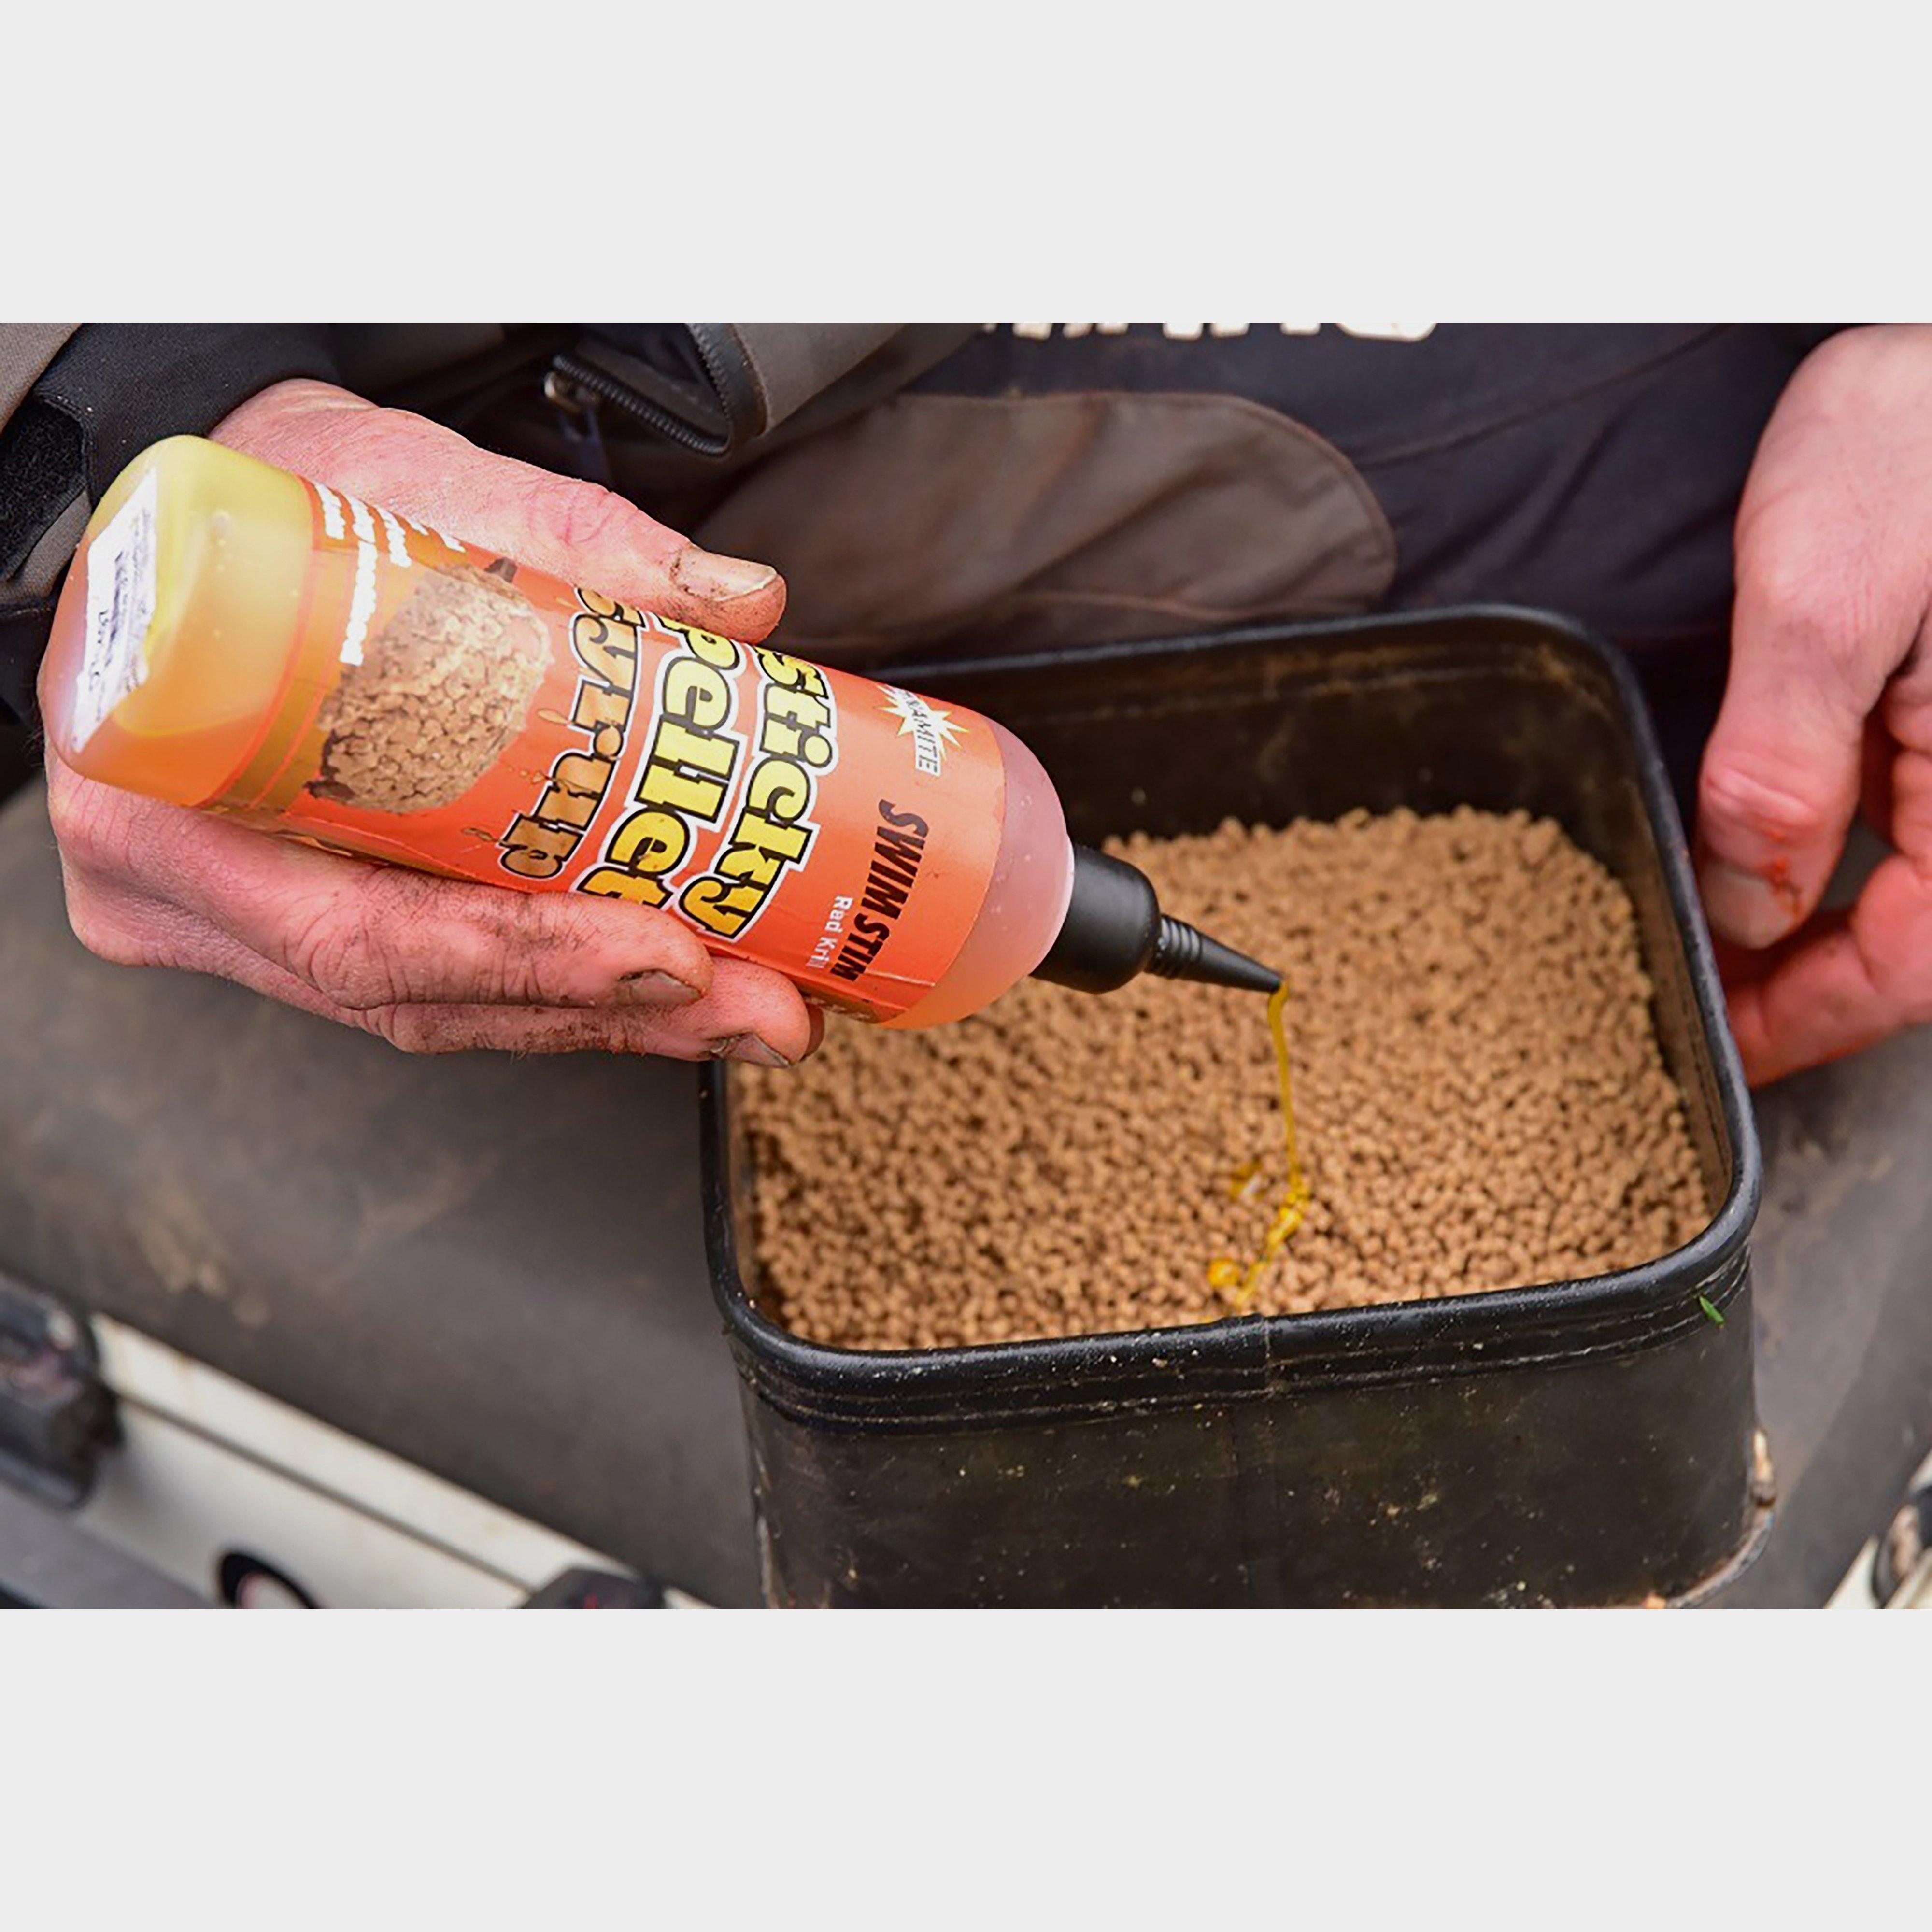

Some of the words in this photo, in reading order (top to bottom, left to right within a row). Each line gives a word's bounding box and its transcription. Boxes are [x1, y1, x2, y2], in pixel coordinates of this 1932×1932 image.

[896, 689, 938, 773] NAMITE
[677, 644, 834, 938] Sticky
[861, 799, 929, 920] SWIM
[824, 895, 853, 933] Red
[830, 913, 890, 981] STIM
